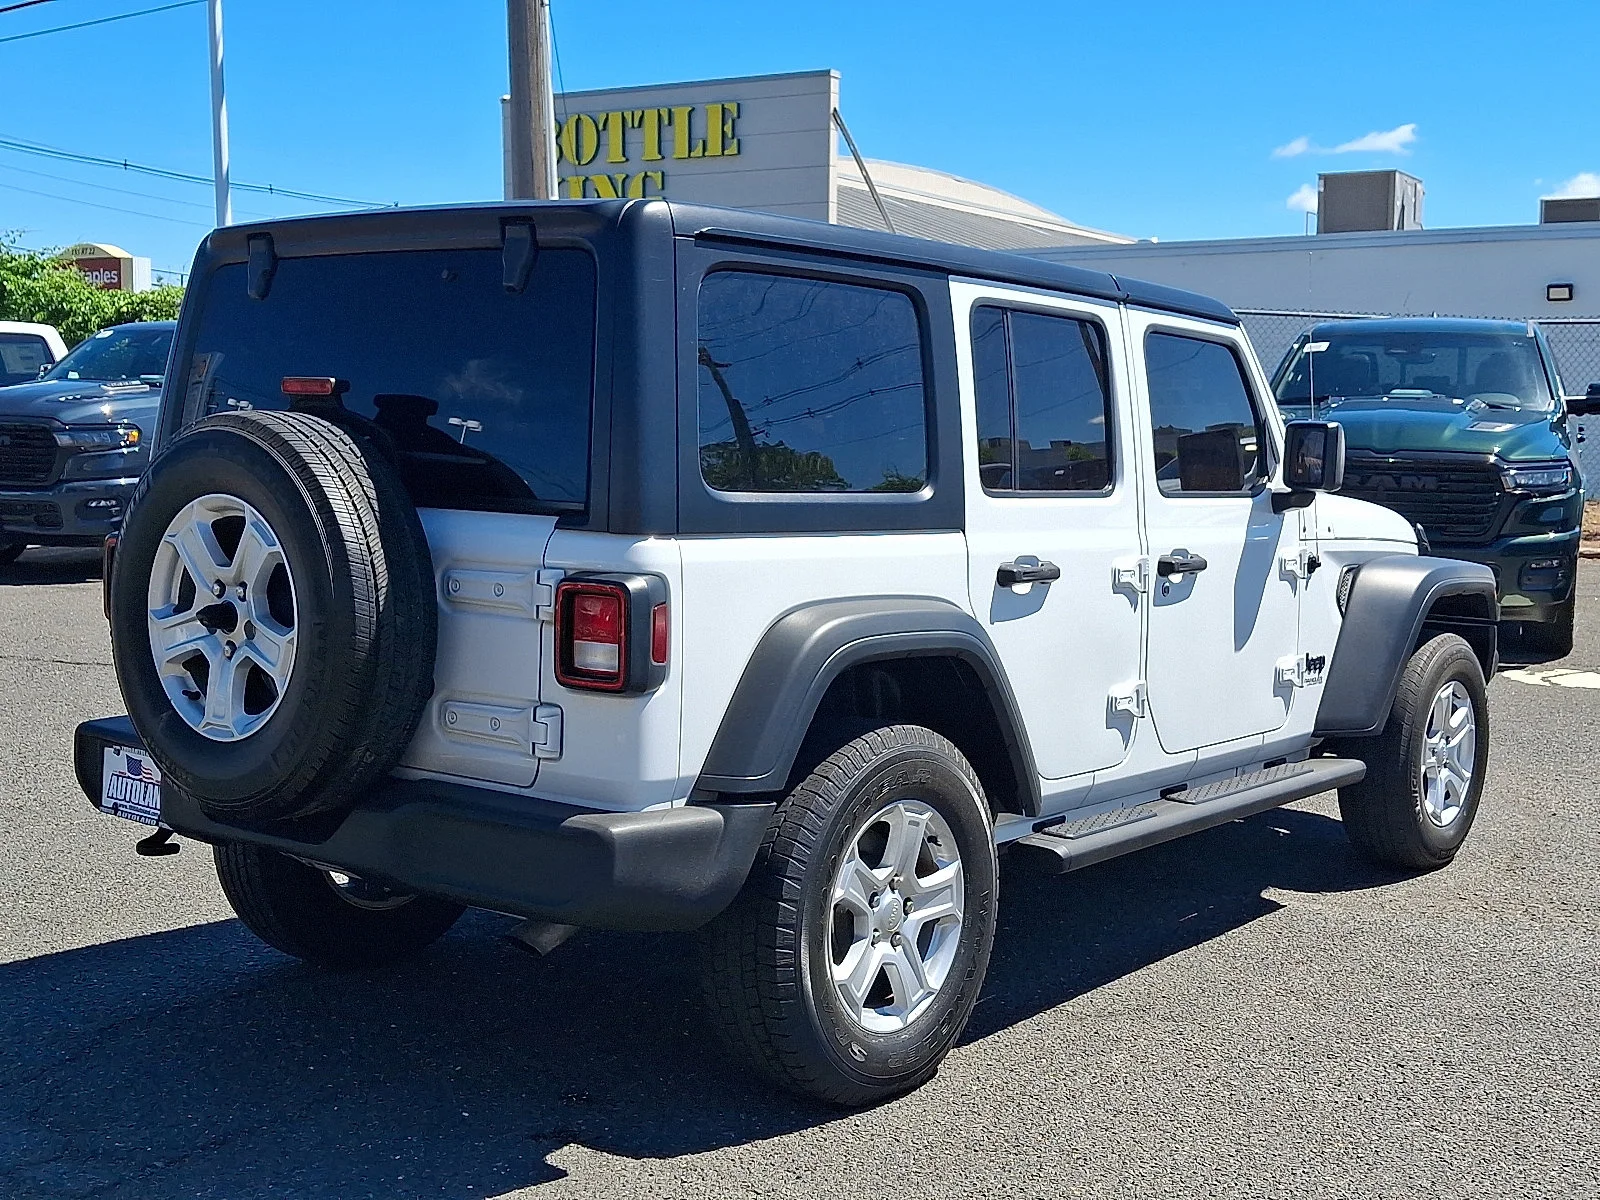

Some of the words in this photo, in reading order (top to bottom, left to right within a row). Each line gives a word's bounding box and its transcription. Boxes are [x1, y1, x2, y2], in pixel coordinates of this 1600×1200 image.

[555, 102, 740, 166] OTTLE
[557, 170, 665, 199] ING
[80, 267, 118, 284] taples
[107, 774, 161, 810] AUTOLAN
[116, 811, 157, 826] AUTOLAND
